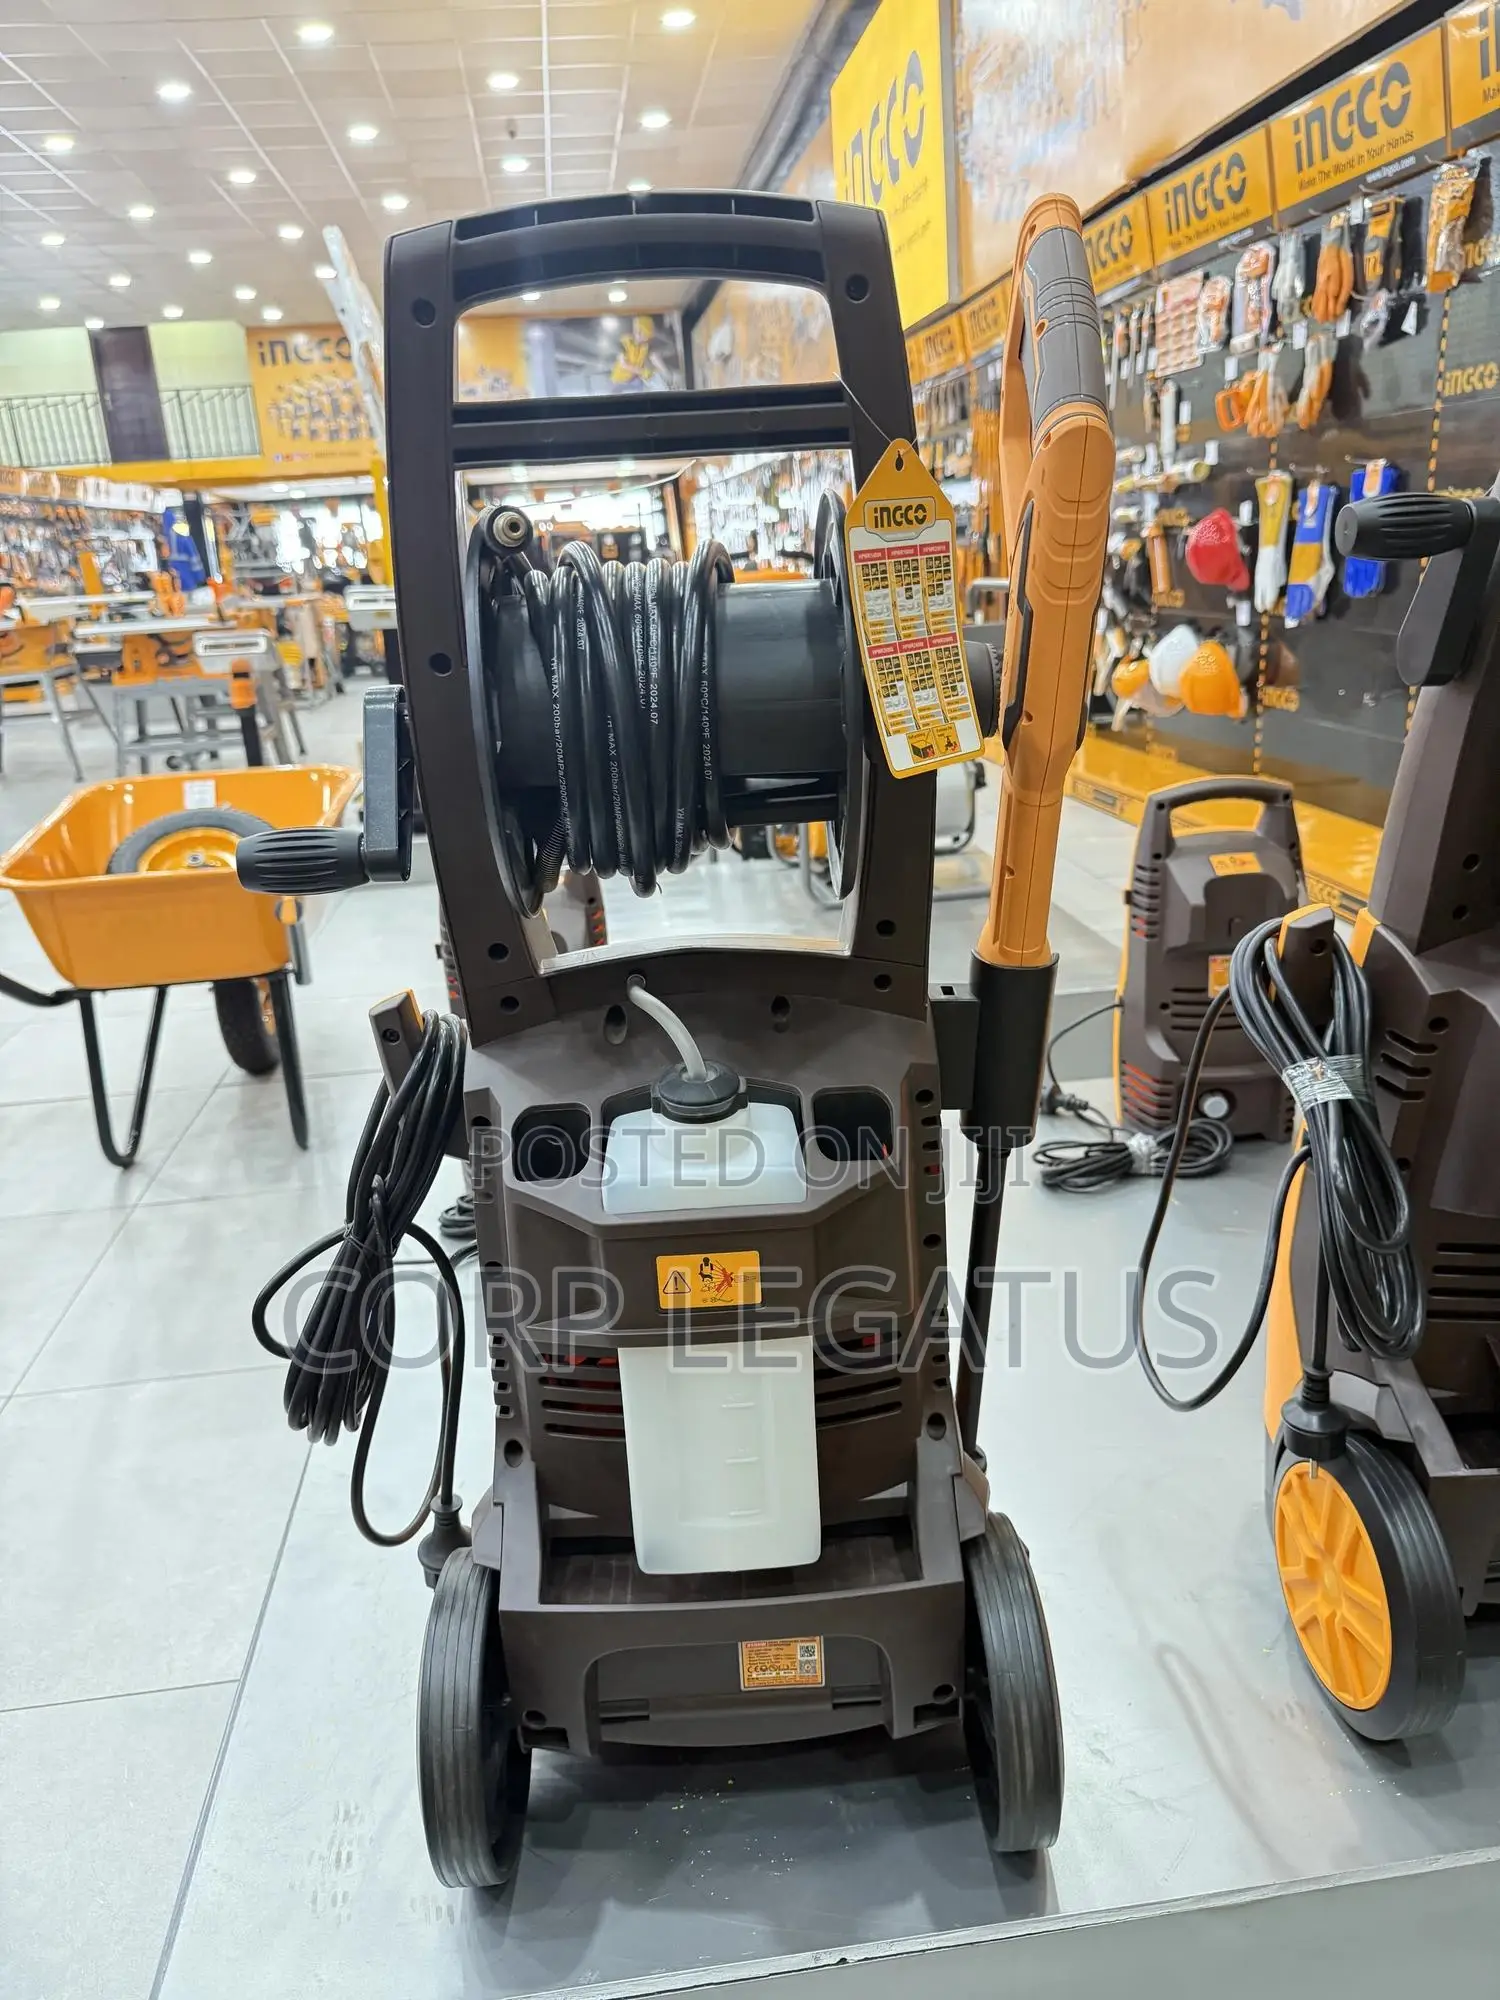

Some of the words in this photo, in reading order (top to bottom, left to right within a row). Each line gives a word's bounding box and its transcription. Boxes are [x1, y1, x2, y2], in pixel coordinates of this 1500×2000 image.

[1293, 61, 1411, 173] INGCO
[1165, 152, 1247, 236] INGCO
[873, 503, 927, 529] INGCO
[551, 674, 561, 699] MAX
[649, 683, 660, 726] 2024.07
[607, 732, 617, 757] MAX
[702, 743, 713, 781] 2024.07
